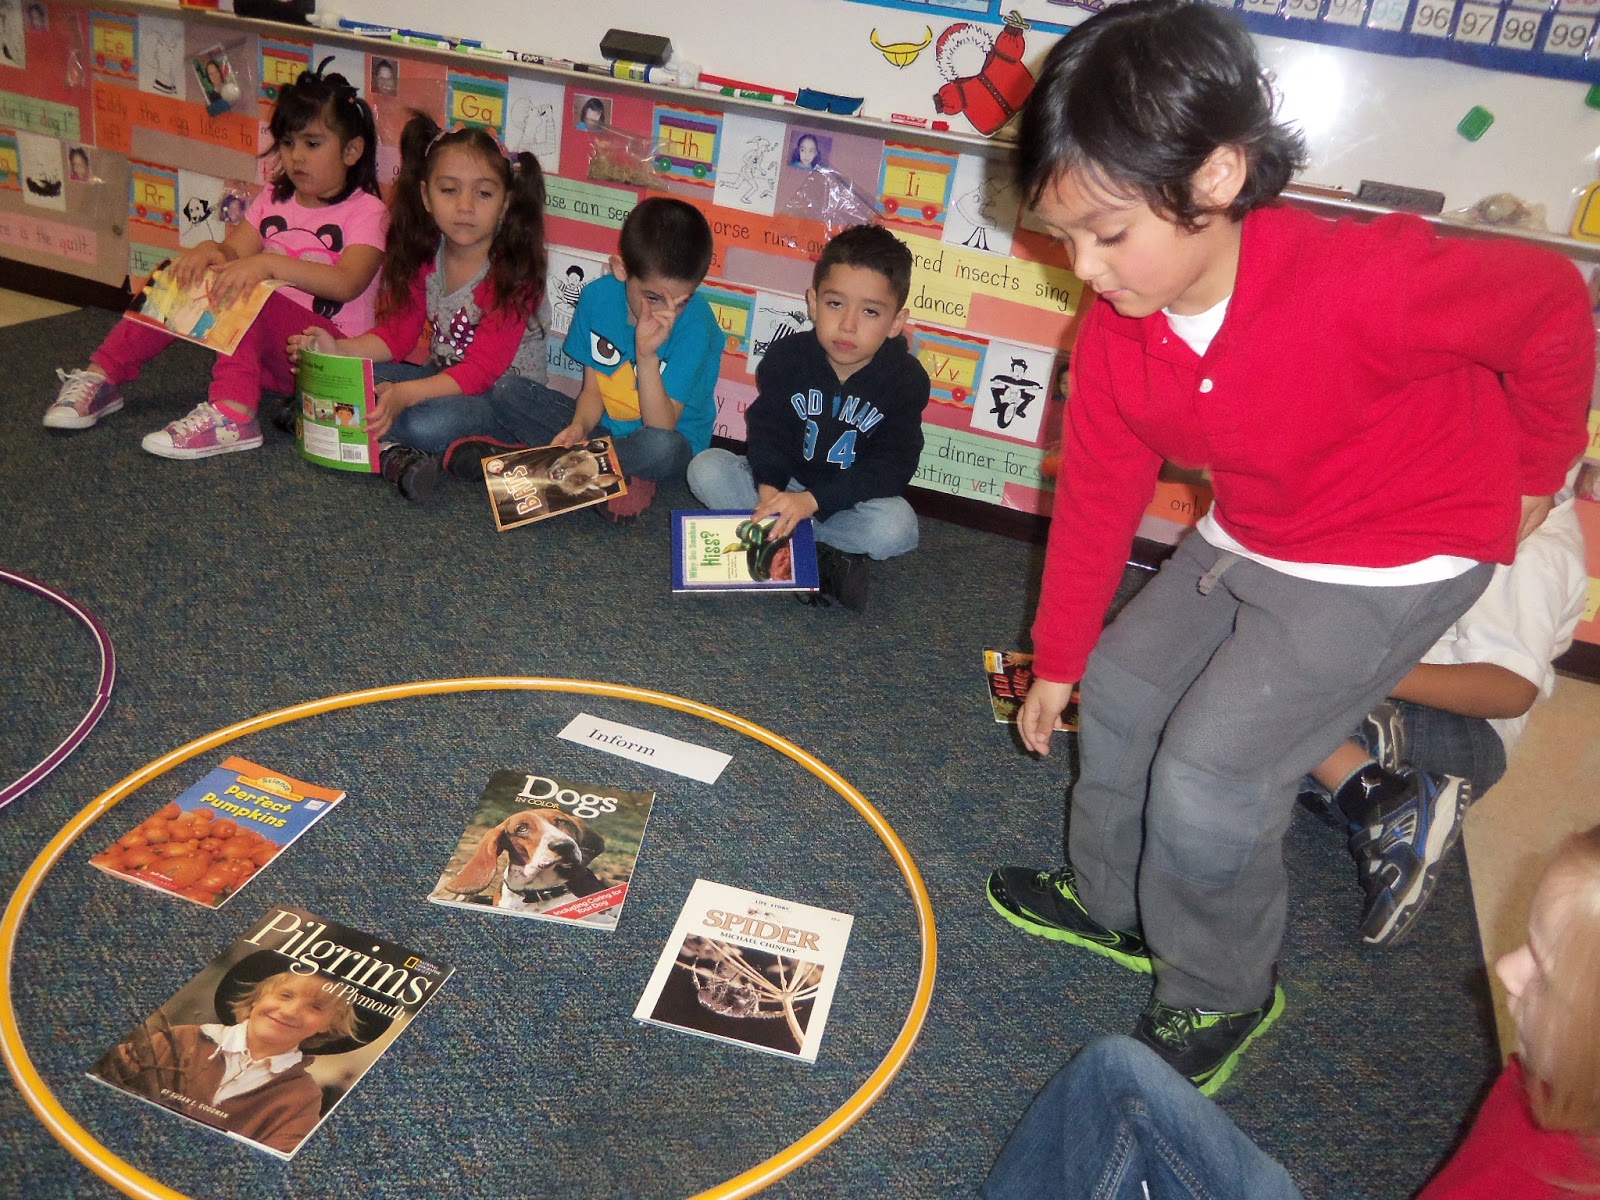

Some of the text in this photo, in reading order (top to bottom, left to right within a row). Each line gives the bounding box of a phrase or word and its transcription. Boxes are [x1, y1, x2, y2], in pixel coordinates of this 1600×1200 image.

[1417, 4, 1449, 31] 96
[1460, 12, 1494, 37] 97
[1503, 17, 1536, 44] 98
[1550, 23, 1587, 49] 99
[104, 29, 125, 54] Ee
[275, 60, 298, 84] Ff
[460, 95, 493, 125] Gg
[139, 103, 161, 125] the
[200, 118, 229, 141] likes
[240, 124, 253, 147] to
[667, 128, 700, 158] Hh
[144, 183, 165, 205] Rr
[906, 171, 921, 197] Ii
[544, 194, 566, 210] ose
[573, 200, 599, 216] can
[713, 221, 750, 240] orse
[763, 230, 798, 249] runs
[133, 250, 150, 271] He
[955, 259, 1020, 292] insects
[1035, 281, 1069, 311] sing
[913, 284, 968, 319] dance.
[933, 354, 960, 381] Vv
[938, 437, 1028, 477] dinner for
[502, 465, 543, 515] BATS
[914, 464, 1000, 498] siting vet.
[700, 530, 722, 567] Hiss?
[586, 728, 656, 757] Inform
[223, 784, 293, 814] Perfect
[262, 777, 291, 793] Science
[517, 774, 619, 819] Dogs
[200, 792, 288, 829] Pumpkins
[515, 796, 560, 810] IN COLOR
[553, 901, 589, 916] Including
[587, 892, 613, 905] Caring
[574, 899, 609, 914] Your Dog
[755, 899, 791, 912] LIFE STORY
[702, 908, 821, 952] SPIDER
[720, 931, 798, 954] MICHAEL CHINERY
[244, 908, 436, 1006] Pilgrims
[321, 981, 406, 1021] of Plymouth
[170, 1092, 191, 1104] SUSAN
[199, 1103, 229, 1119] GOODMAN
